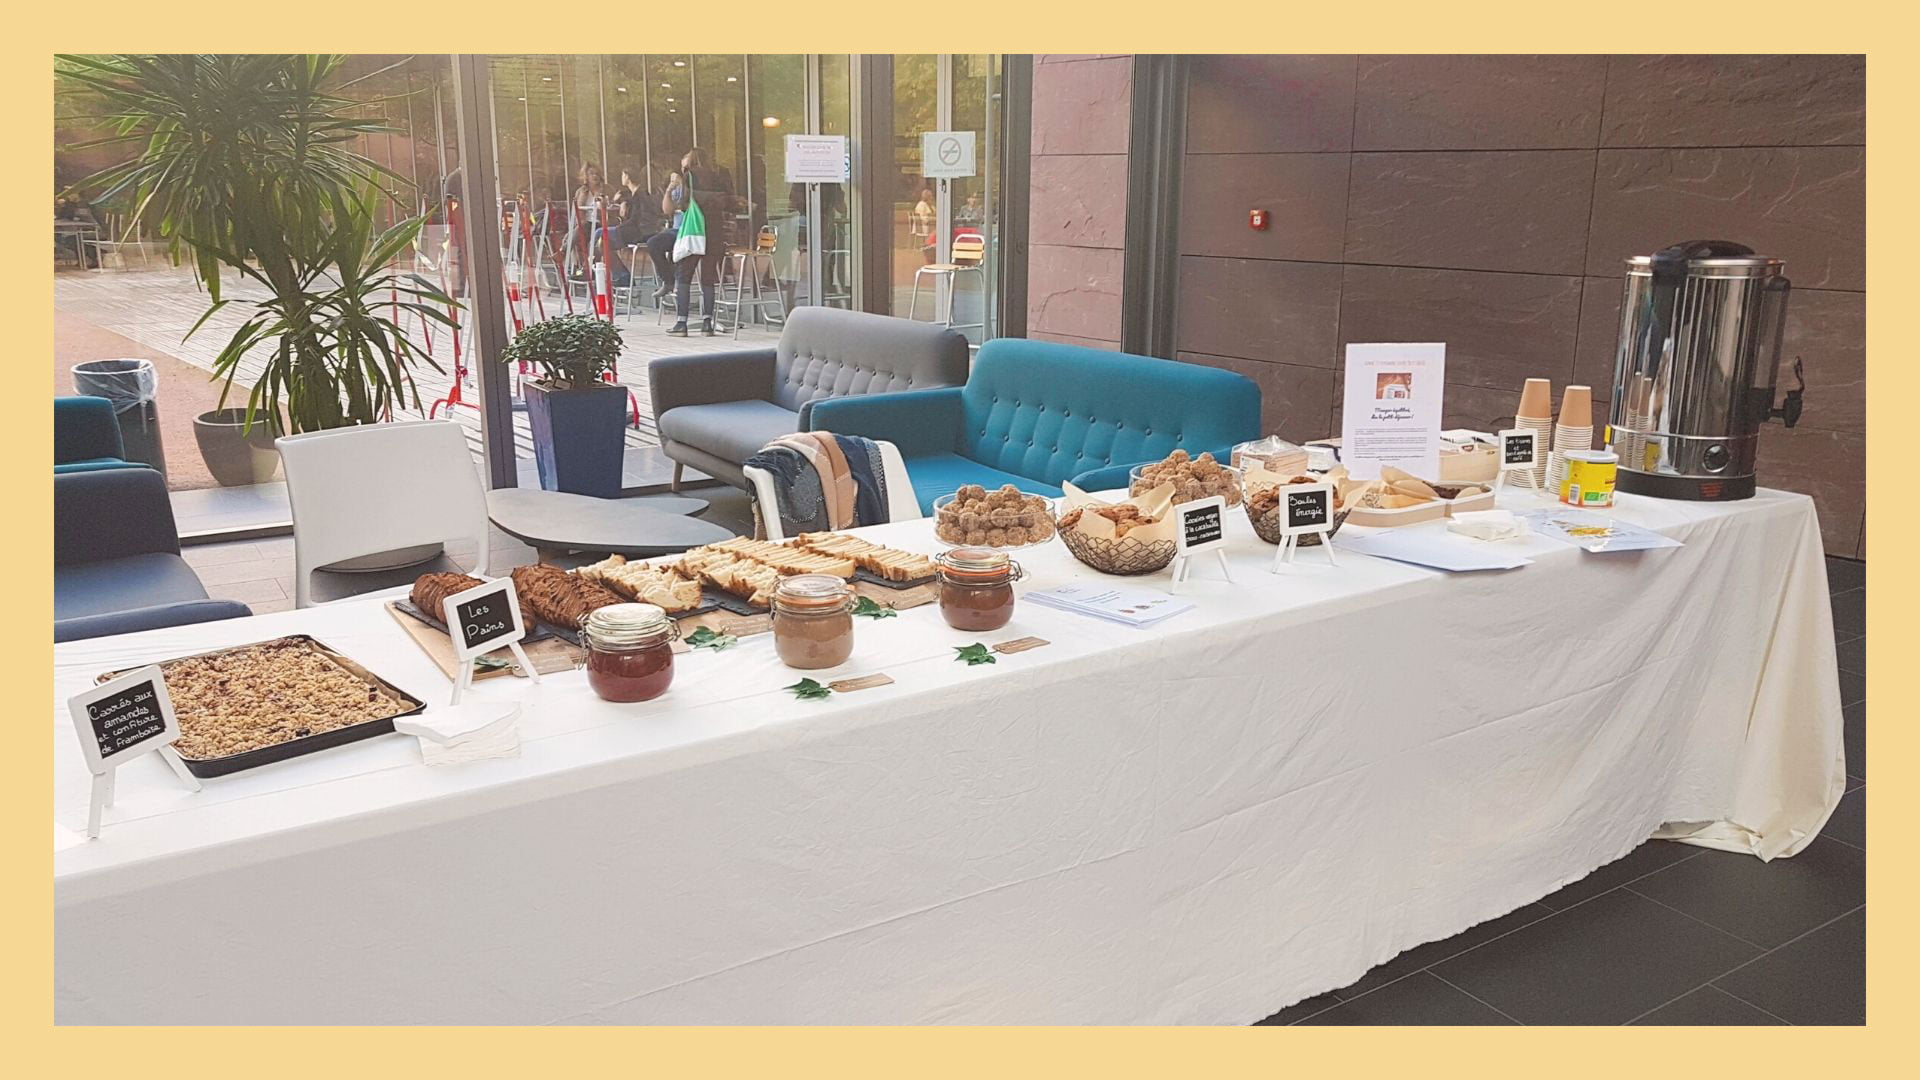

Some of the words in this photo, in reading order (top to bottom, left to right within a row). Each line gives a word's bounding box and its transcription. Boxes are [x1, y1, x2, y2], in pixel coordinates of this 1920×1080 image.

[1288, 495, 1317, 507] Boules
[467, 605, 490, 619] Les
[466, 621, 505, 640] Pains
[88, 698, 132, 721] Carrés
[134, 690, 153, 703] aux
[98, 733, 110, 743] et
[112, 715, 159, 736] confiture
[104, 706, 149, 729] amandes
[101, 745, 114, 754] de
[116, 725, 161, 747] framboise
